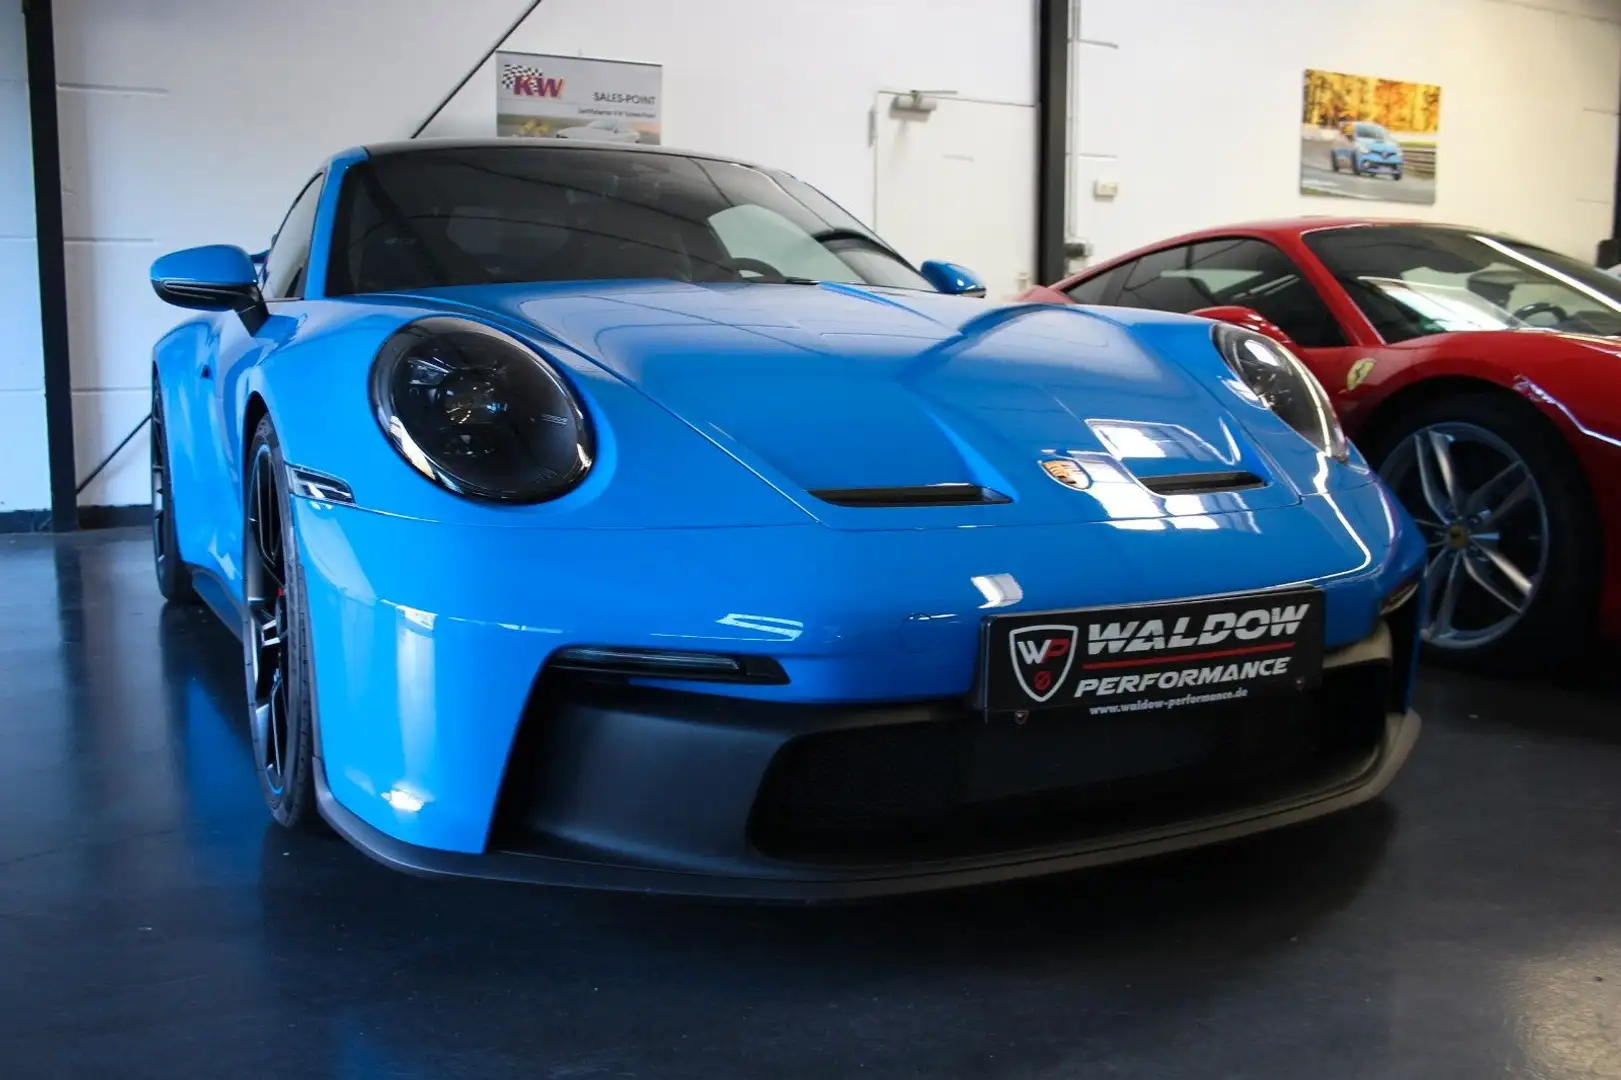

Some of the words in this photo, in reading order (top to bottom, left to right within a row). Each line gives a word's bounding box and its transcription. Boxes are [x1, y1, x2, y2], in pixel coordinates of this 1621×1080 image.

[513, 75, 563, 98] KW
[594, 92, 656, 105] SALES-POINT
[1087, 604, 1310, 655] WALDOW
[1016, 638, 1070, 664] WP
[1074, 656, 1292, 697] PERFORMANCE
[1089, 687, 1248, 715] www.waldow-performance.de
